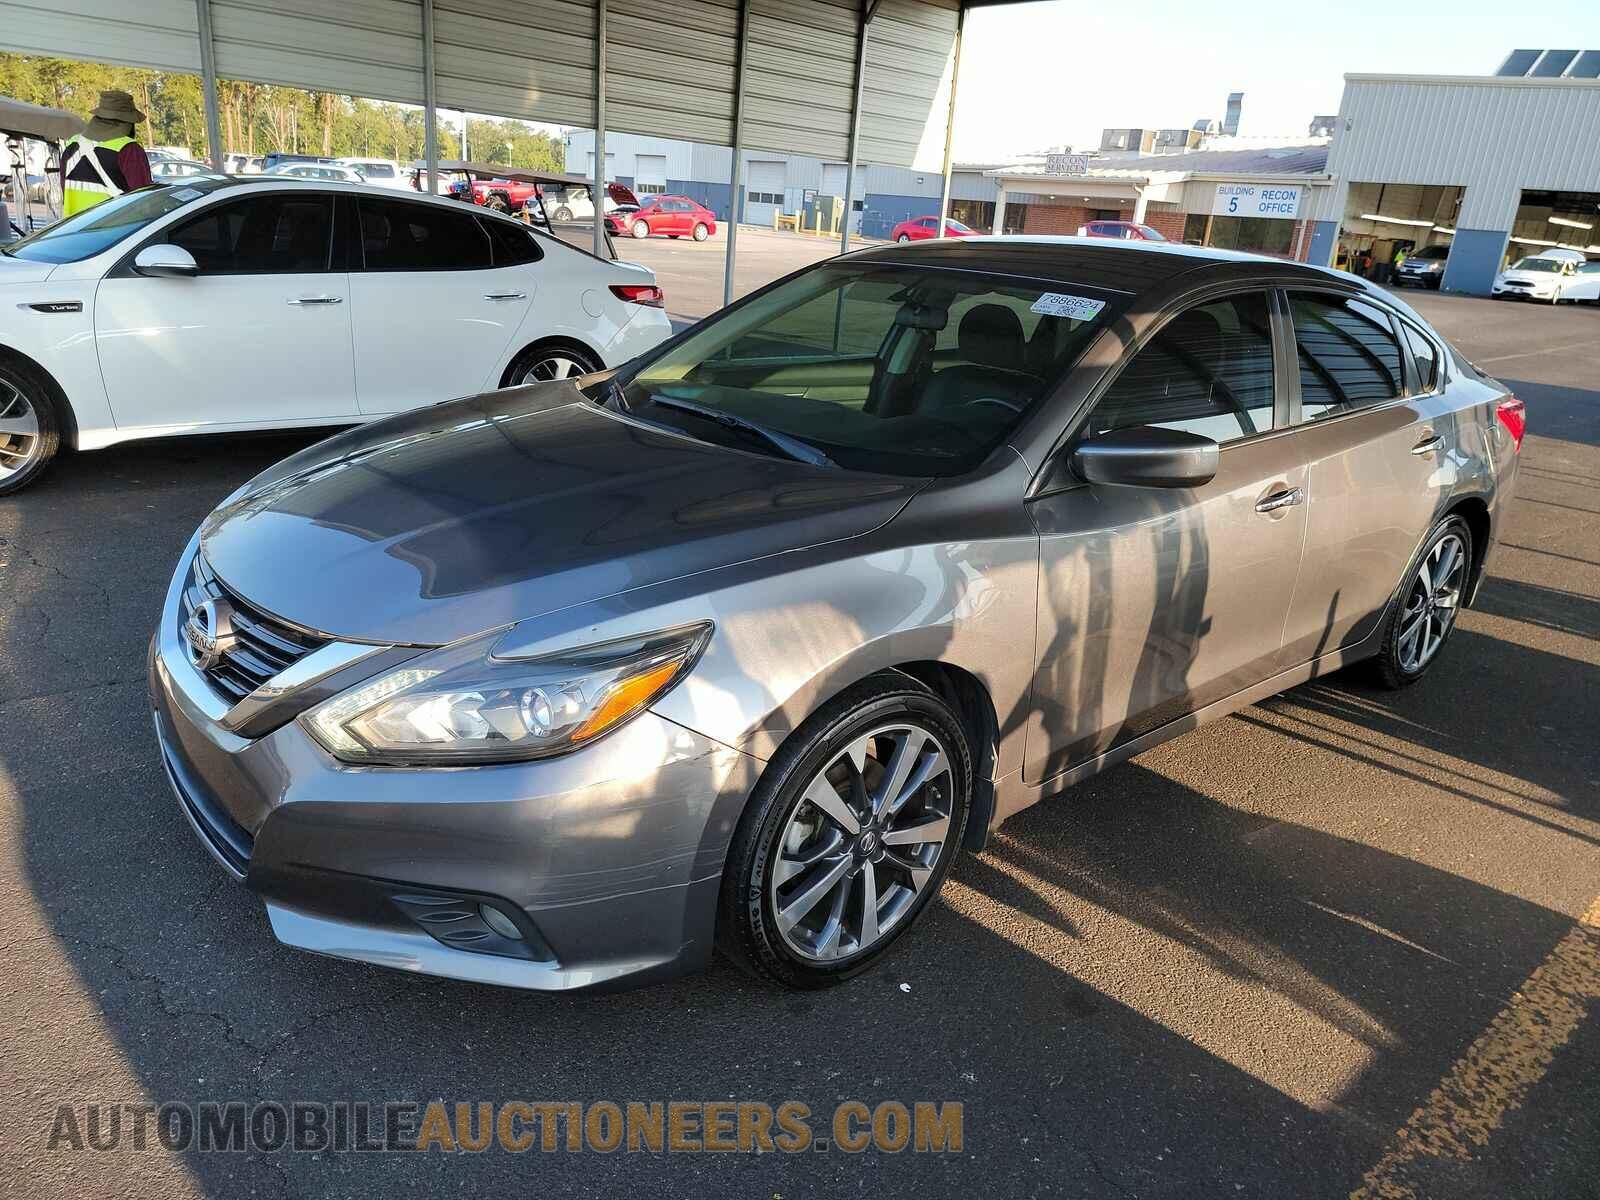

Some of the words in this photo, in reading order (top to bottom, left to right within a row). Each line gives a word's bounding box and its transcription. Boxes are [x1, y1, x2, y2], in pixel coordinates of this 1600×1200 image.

[1048, 156, 1086, 165] RECON
[1219, 186, 1256, 196] BUILDING
[1261, 190, 1297, 201] RECON
[1228, 197, 1240, 213] 5
[1259, 202, 1294, 213] OFFICE
[1040, 294, 1099, 309] 7886624
